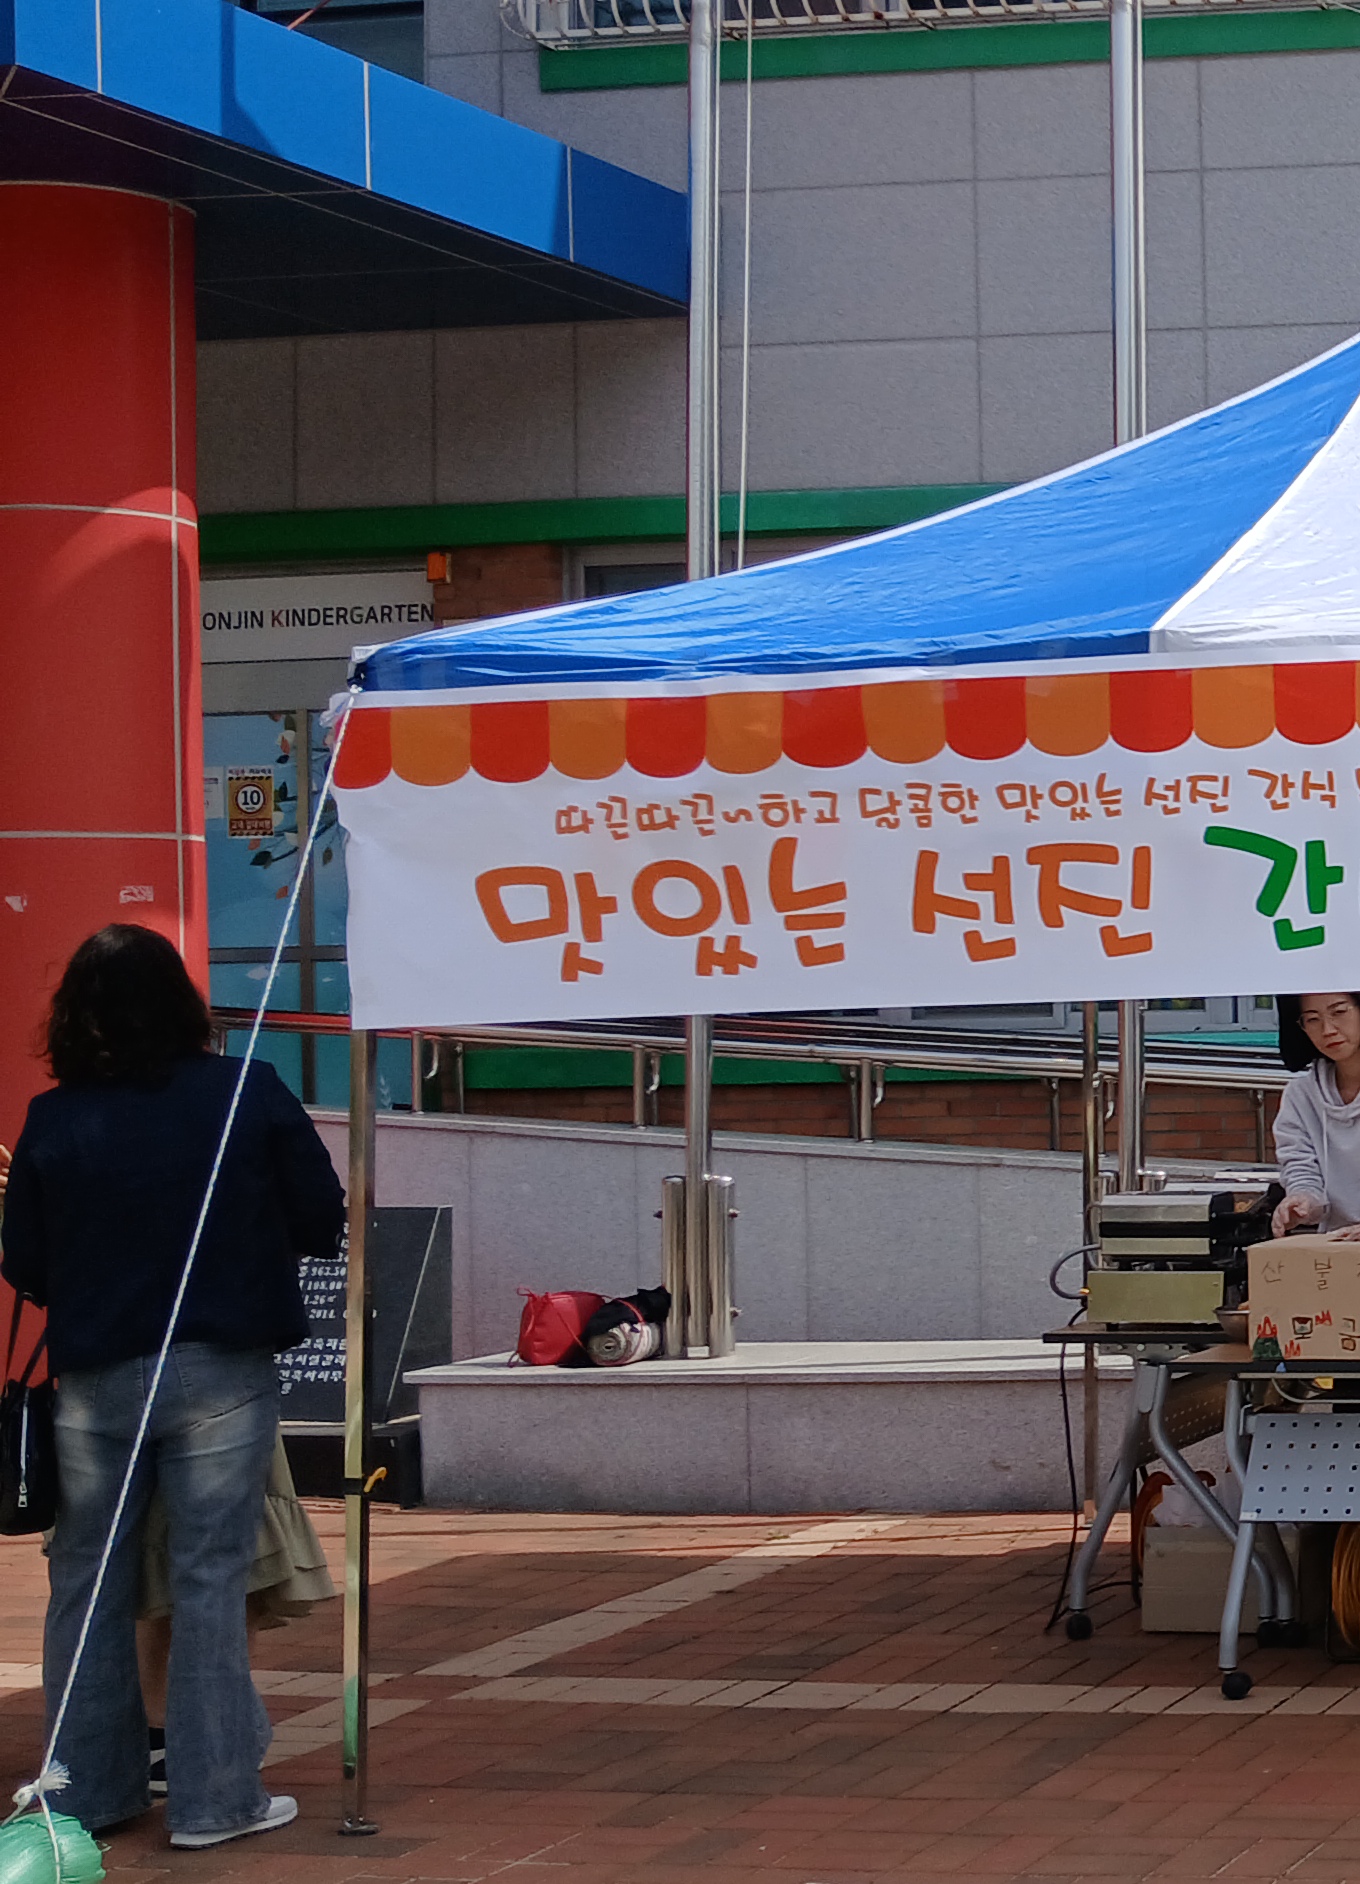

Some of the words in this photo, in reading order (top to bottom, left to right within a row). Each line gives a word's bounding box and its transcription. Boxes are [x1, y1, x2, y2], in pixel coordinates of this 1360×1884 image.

[202, 610, 264, 631] ONJIN
[271, 603, 434, 628] KINDERGARTEN
[241, 789, 261, 806] 10
[858, 782, 979, 830] 달콤한
[995, 772, 1122, 823] 맛있는
[1143, 774, 1230, 816] 선진
[1247, 768, 1337, 812] 간식
[475, 836, 848, 982] 맛있는
[912, 841, 1154, 962] 선진
